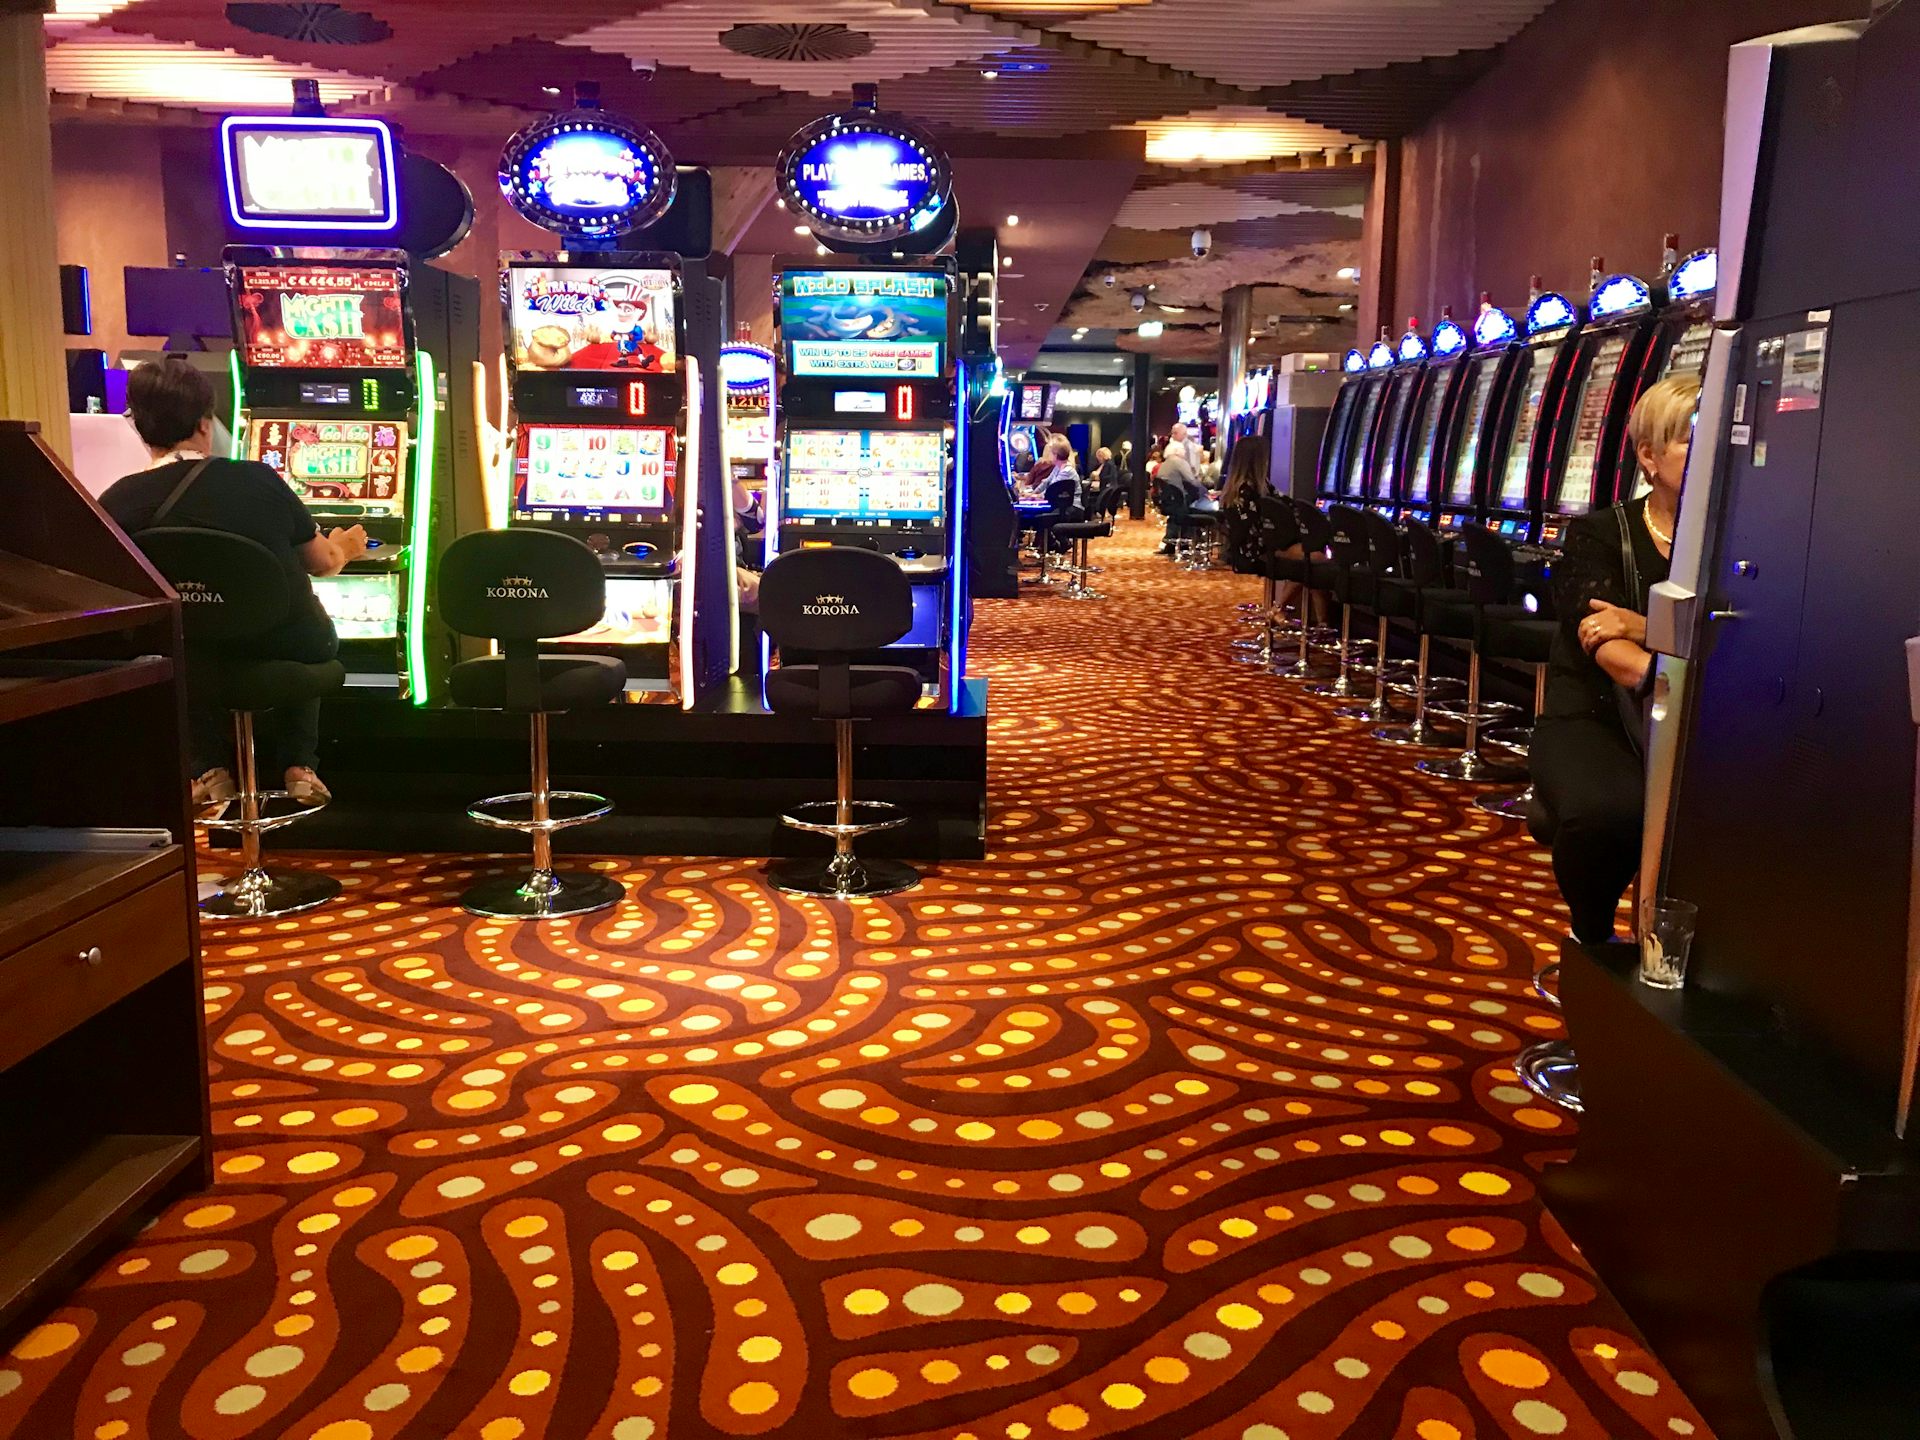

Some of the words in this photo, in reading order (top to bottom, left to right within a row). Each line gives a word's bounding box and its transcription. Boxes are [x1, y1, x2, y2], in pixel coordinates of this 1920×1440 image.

[803, 163, 835, 181] PLAY
[892, 163, 928, 183] AMES,
[793, 277, 849, 296] WILD
[854, 277, 934, 297] SPLASH
[282, 293, 363, 318] MIGHTY
[537, 295, 596, 314] Wilds
[799, 348, 819, 357] WIN
[821, 348, 836, 357] UP
[837, 348, 850, 357] TO
[897, 349, 932, 357] GAMES
[810, 358, 835, 368] WITH
[837, 358, 868, 368] EXTRA
[870, 358, 896, 368] WILD
[630, 382, 645, 415] 0
[898, 385, 912, 420] 0
[178, 592, 225, 603] RONA
[486, 587, 550, 599] KORONA
[802, 605, 860, 616] KORONA
